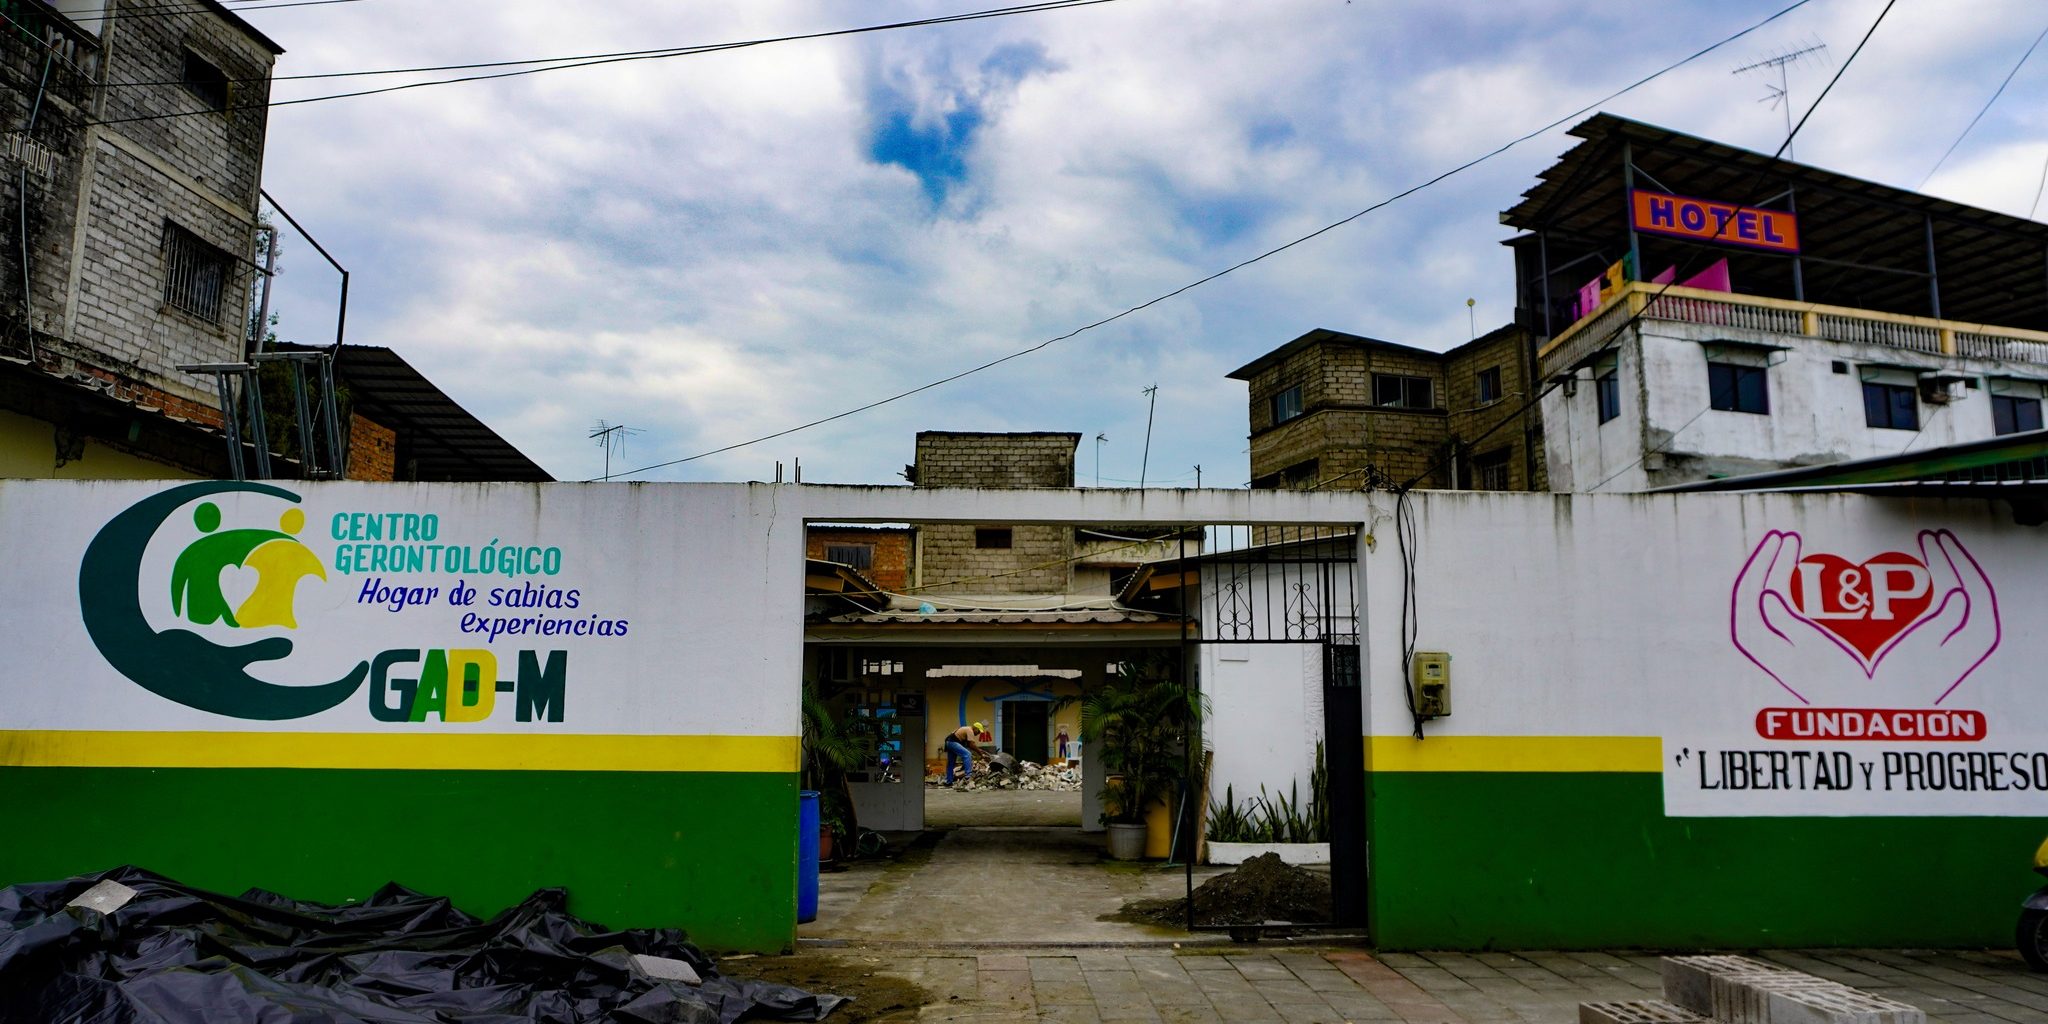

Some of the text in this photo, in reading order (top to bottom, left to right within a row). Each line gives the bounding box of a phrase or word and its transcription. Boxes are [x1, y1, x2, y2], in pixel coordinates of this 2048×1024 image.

[1649, 197, 1784, 244] HOTEL
[331, 512, 438, 541] CENTRO
[335, 538, 561, 578] GERONTOLÓGICO
[358, 578, 580, 612] Hogar de sabias
[1798, 562, 1931, 620] L&P
[460, 612, 629, 643] experiencias
[369, 648, 567, 722] GAD-M
[1883, 752, 2048, 791] PROGRESO
